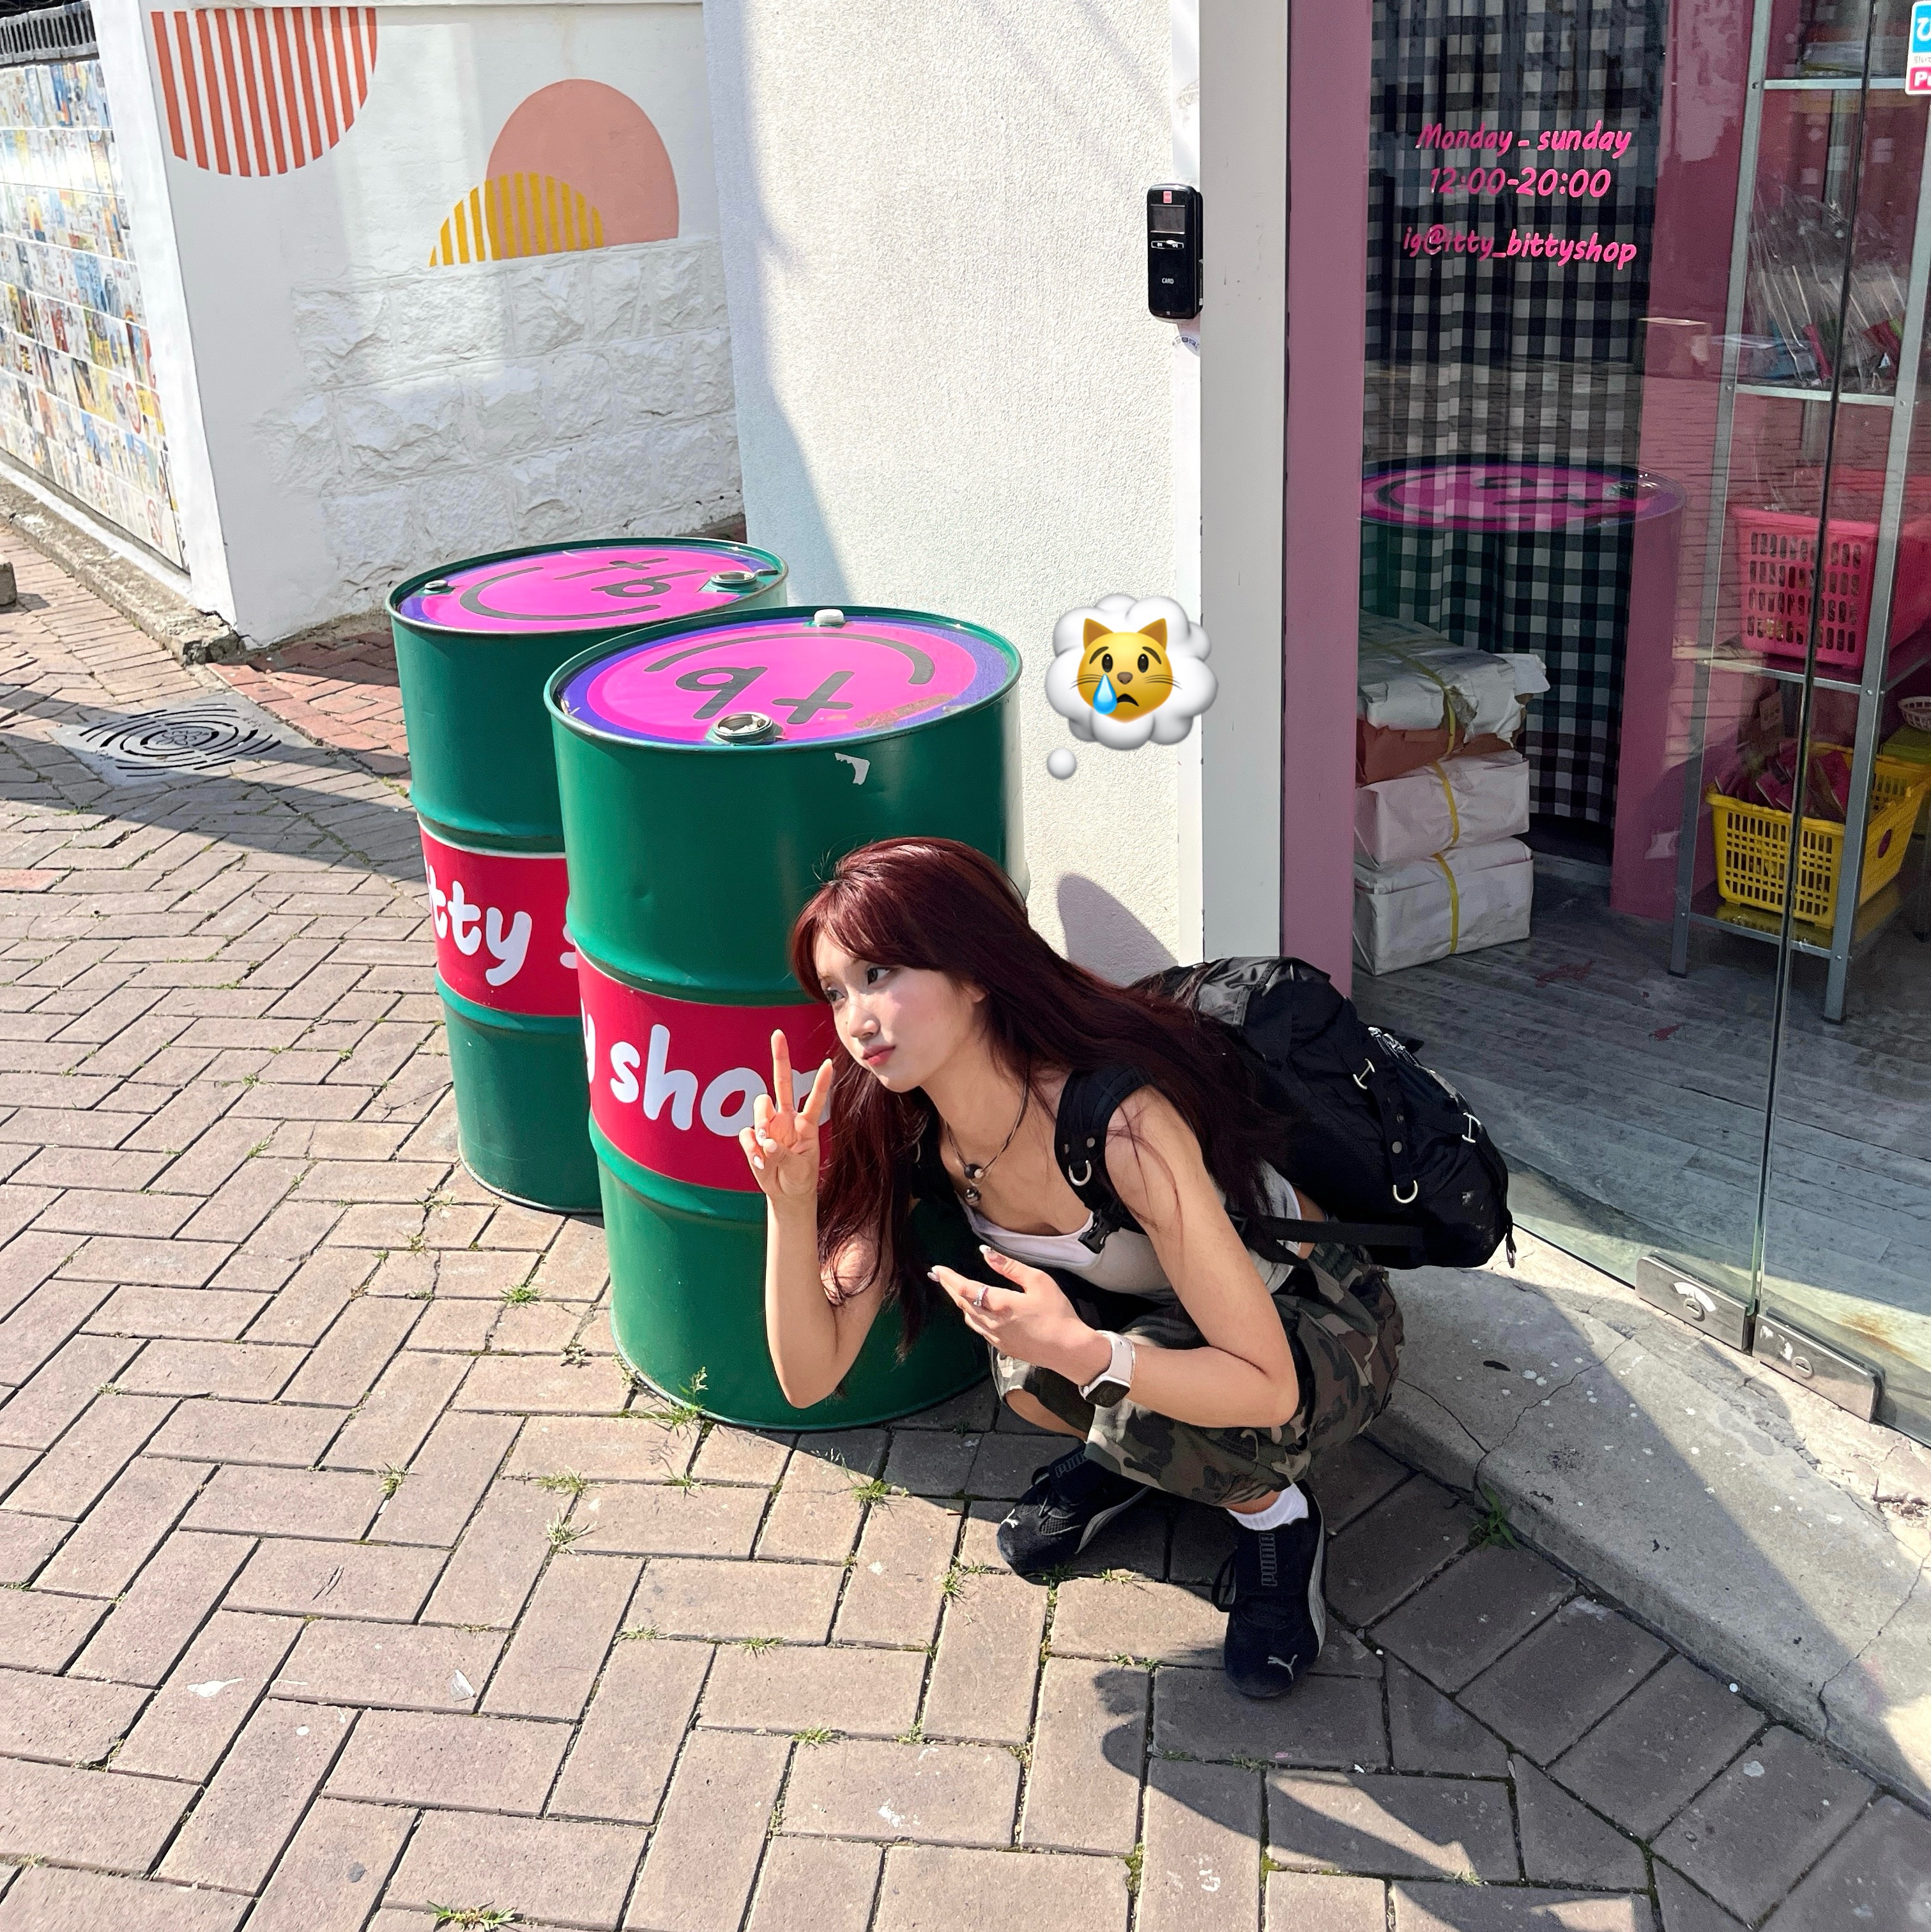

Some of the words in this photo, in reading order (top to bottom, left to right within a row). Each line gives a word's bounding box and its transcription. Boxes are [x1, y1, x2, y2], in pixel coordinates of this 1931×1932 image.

[1416, 121, 1513, 157] Monday
[1537, 119, 1632, 159] sunday
[1430, 167, 1612, 198] 12:00-20:00
[1403, 224, 1637, 270] ig@itty_bittyshop
[424, 855, 533, 987] tty
